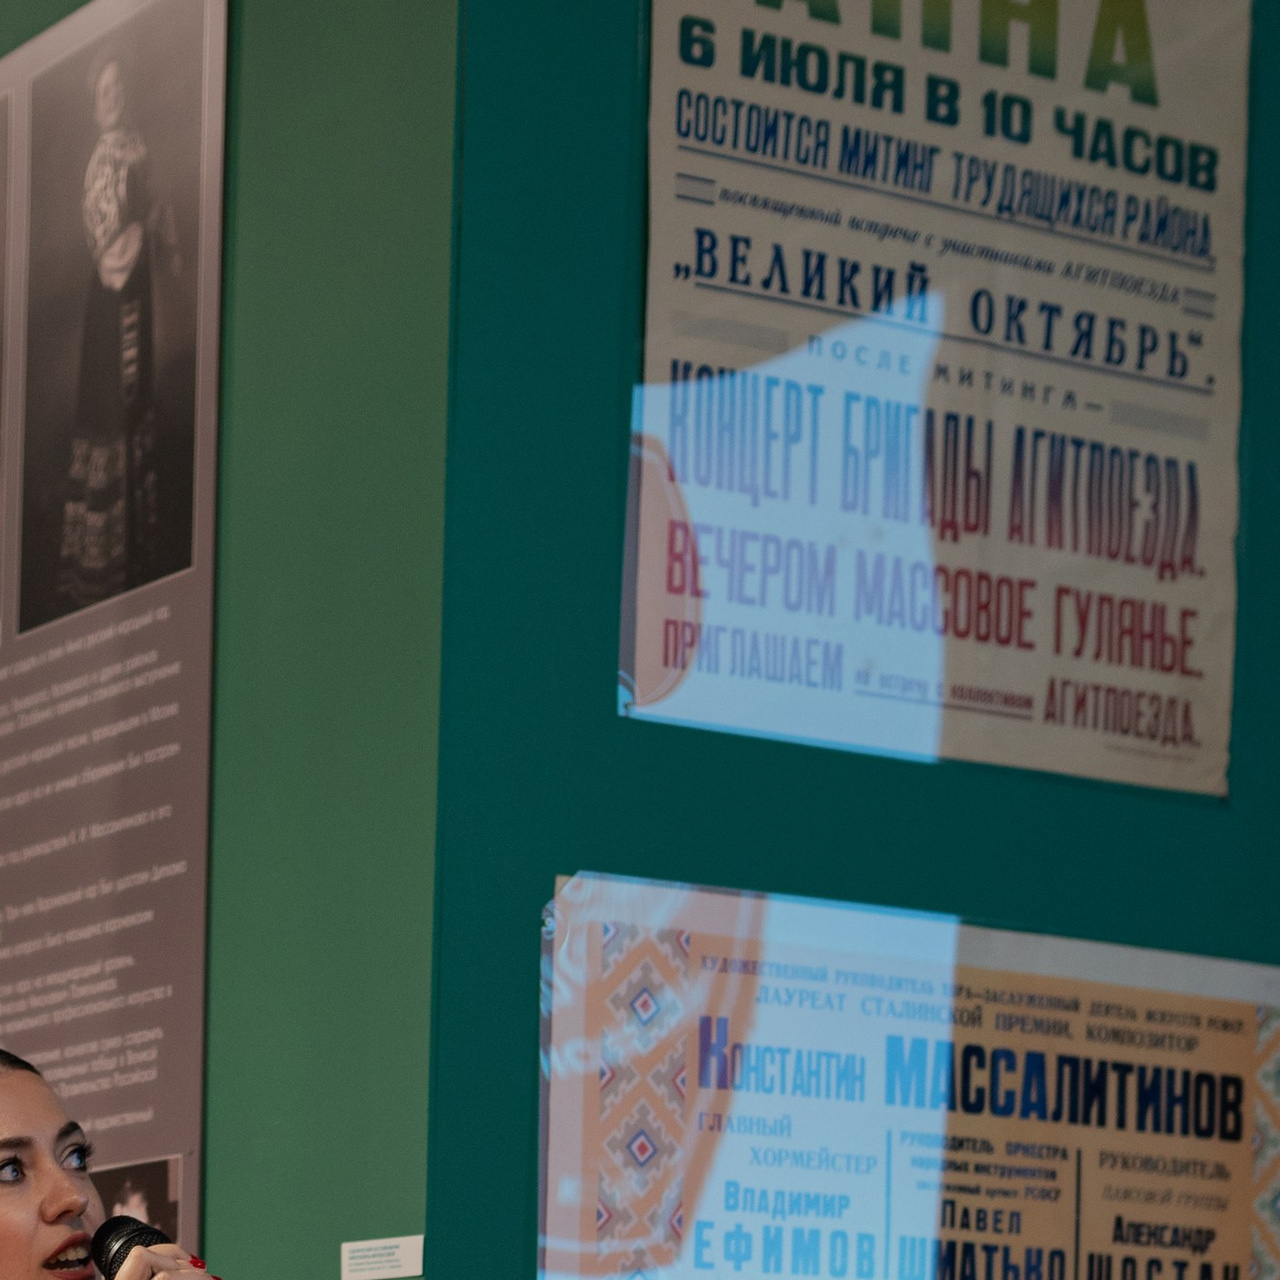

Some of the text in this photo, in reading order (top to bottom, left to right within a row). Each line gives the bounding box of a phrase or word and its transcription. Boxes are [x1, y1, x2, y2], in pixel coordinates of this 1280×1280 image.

[679, 15, 1219, 193] 6 ИЮЛЯ В 10 ЧАСОВ
[675, 87, 830, 170] СОСТОИТСЯ
[837, 123, 941, 194] МИТИНГ
[952, 151, 1118, 236] ТРУДЯЩИХСЯ
[808, 333, 912, 376] ПОСЛЕ
[667, 358, 825, 508] КОНЦЕРТ
[840, 389, 994, 544] БРИГАДЫ
[666, 517, 837, 618] ВЕЧЕРОМ
[854, 548, 1037, 651] МАССОВОЕ
[662, 616, 844, 693] ПРИГЛАШАЕМ
[754, 984, 848, 1014] ЛАУРЕАТ
[859, 995, 984, 1029] СТАЛИНСКОЙ
[1084, 1022, 1200, 1055] КОМПОЗИТОР
[883, 1033, 1245, 1143] МАССАЛИТИНОВ
[697, 1110, 794, 1139] ГЛАВНЫЙ
[749, 1145, 879, 1175] ХОРМЕЙСТЕР
[899, 1129, 1069, 1162] РУКОВОДИТЕЛЬ ОРКЕСТРА
[1098, 1149, 1232, 1182] РУКОВОДИТЕЛЬ
[693, 1219, 877, 1280] ЕФИМОВ
